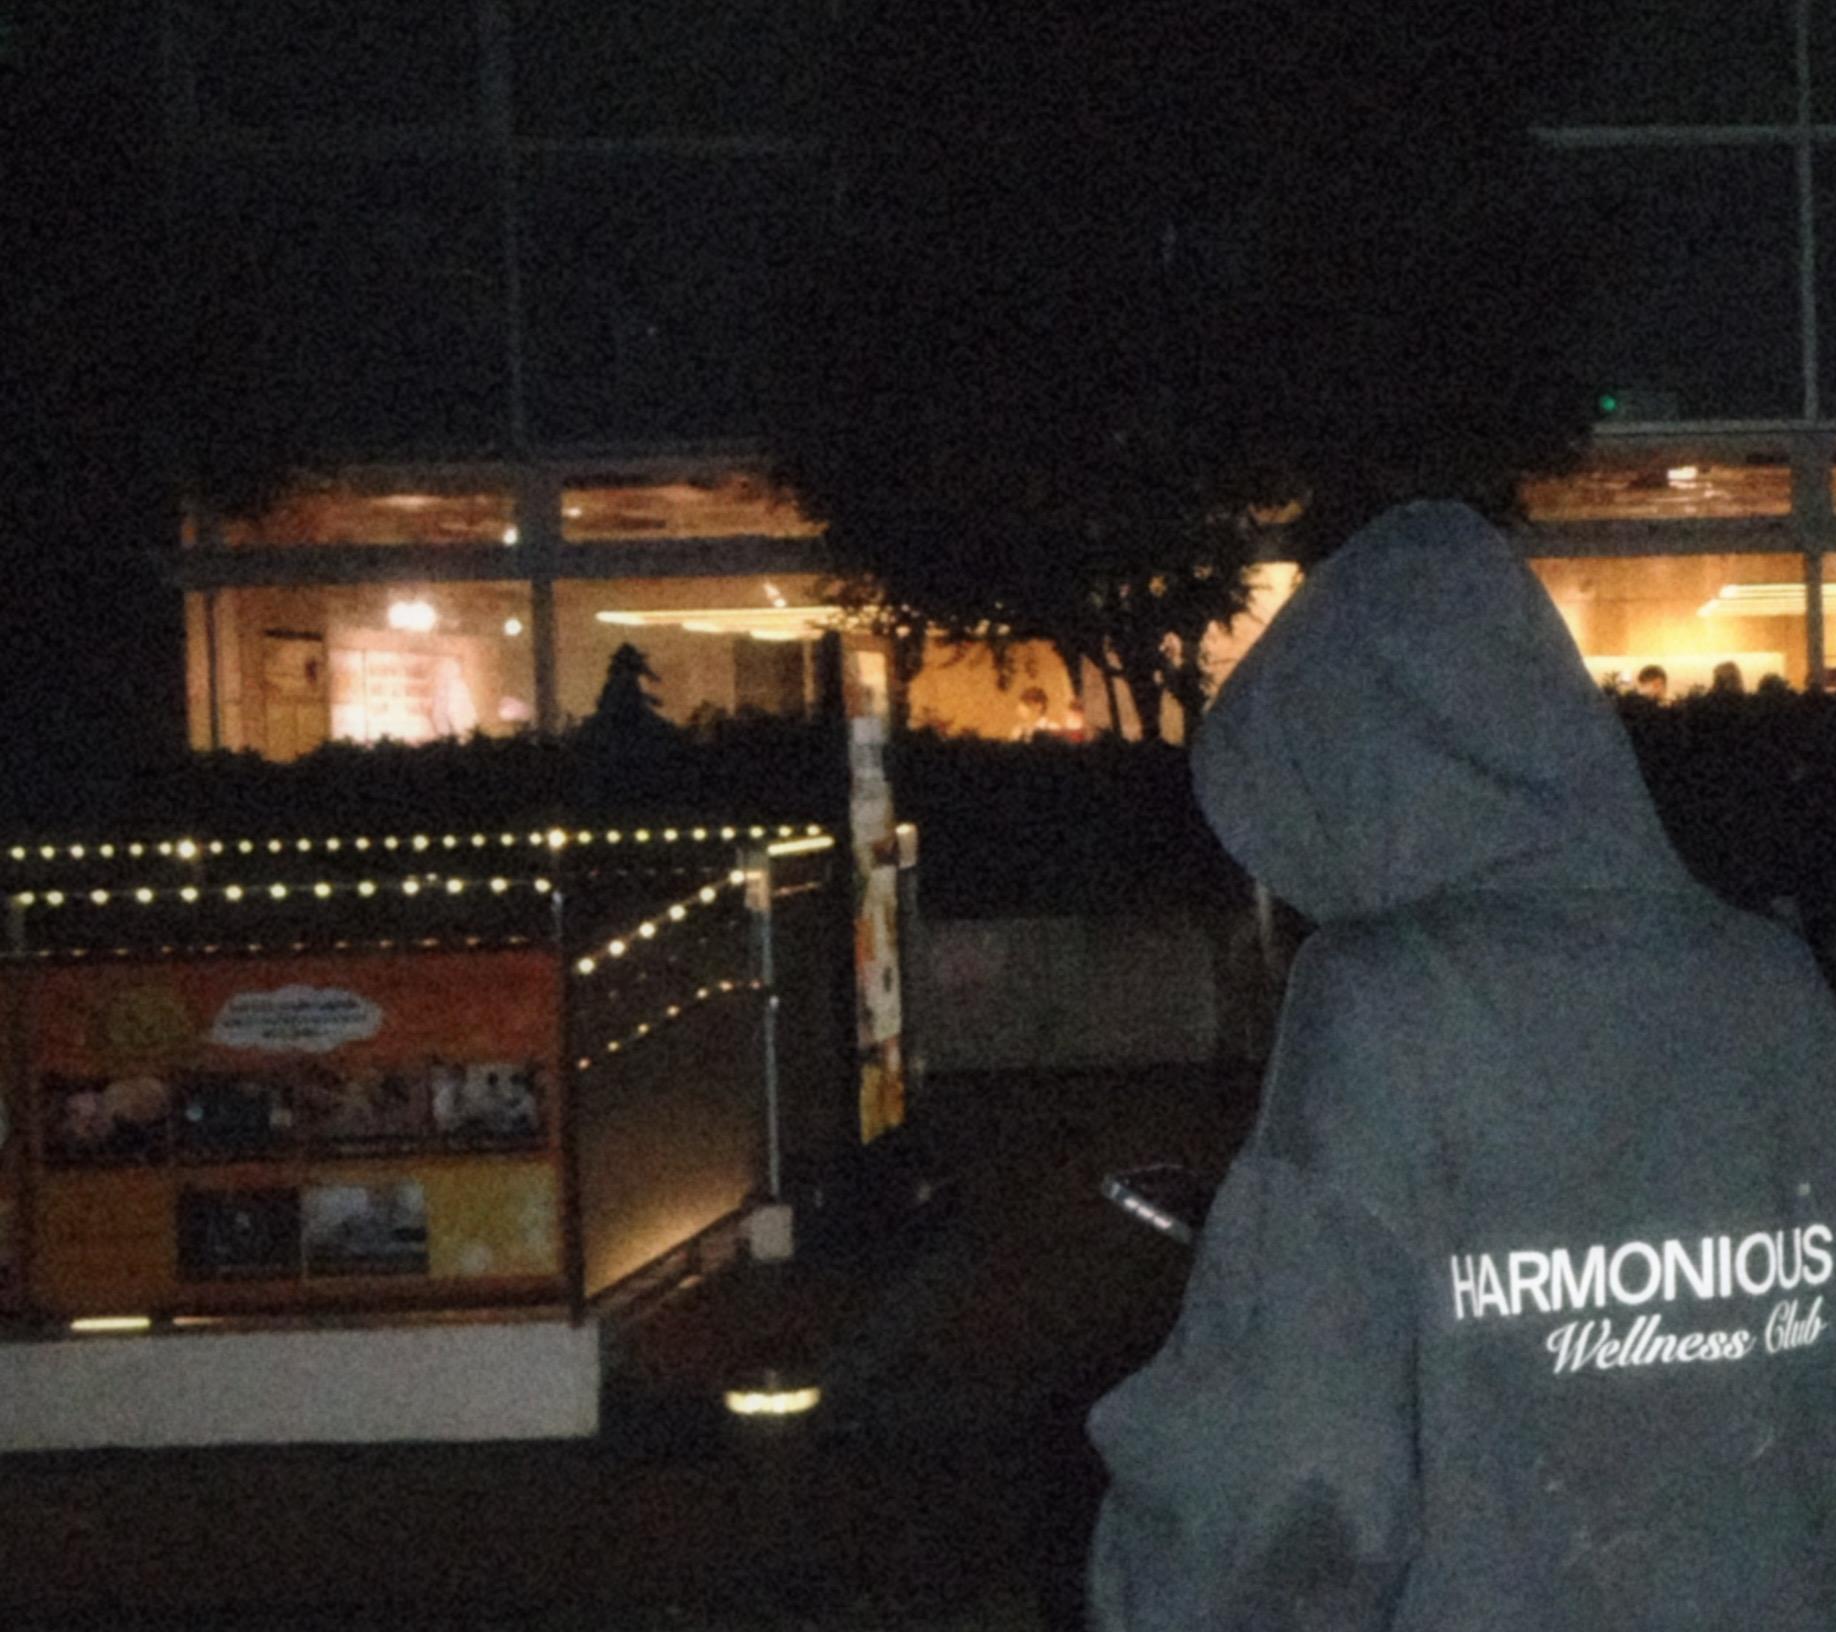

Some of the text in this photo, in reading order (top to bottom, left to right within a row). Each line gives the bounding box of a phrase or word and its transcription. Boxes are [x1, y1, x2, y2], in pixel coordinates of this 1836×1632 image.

[1452, 1224, 1833, 1319] HARMONIOUS
[1547, 1297, 1826, 1373] Wellness Club
